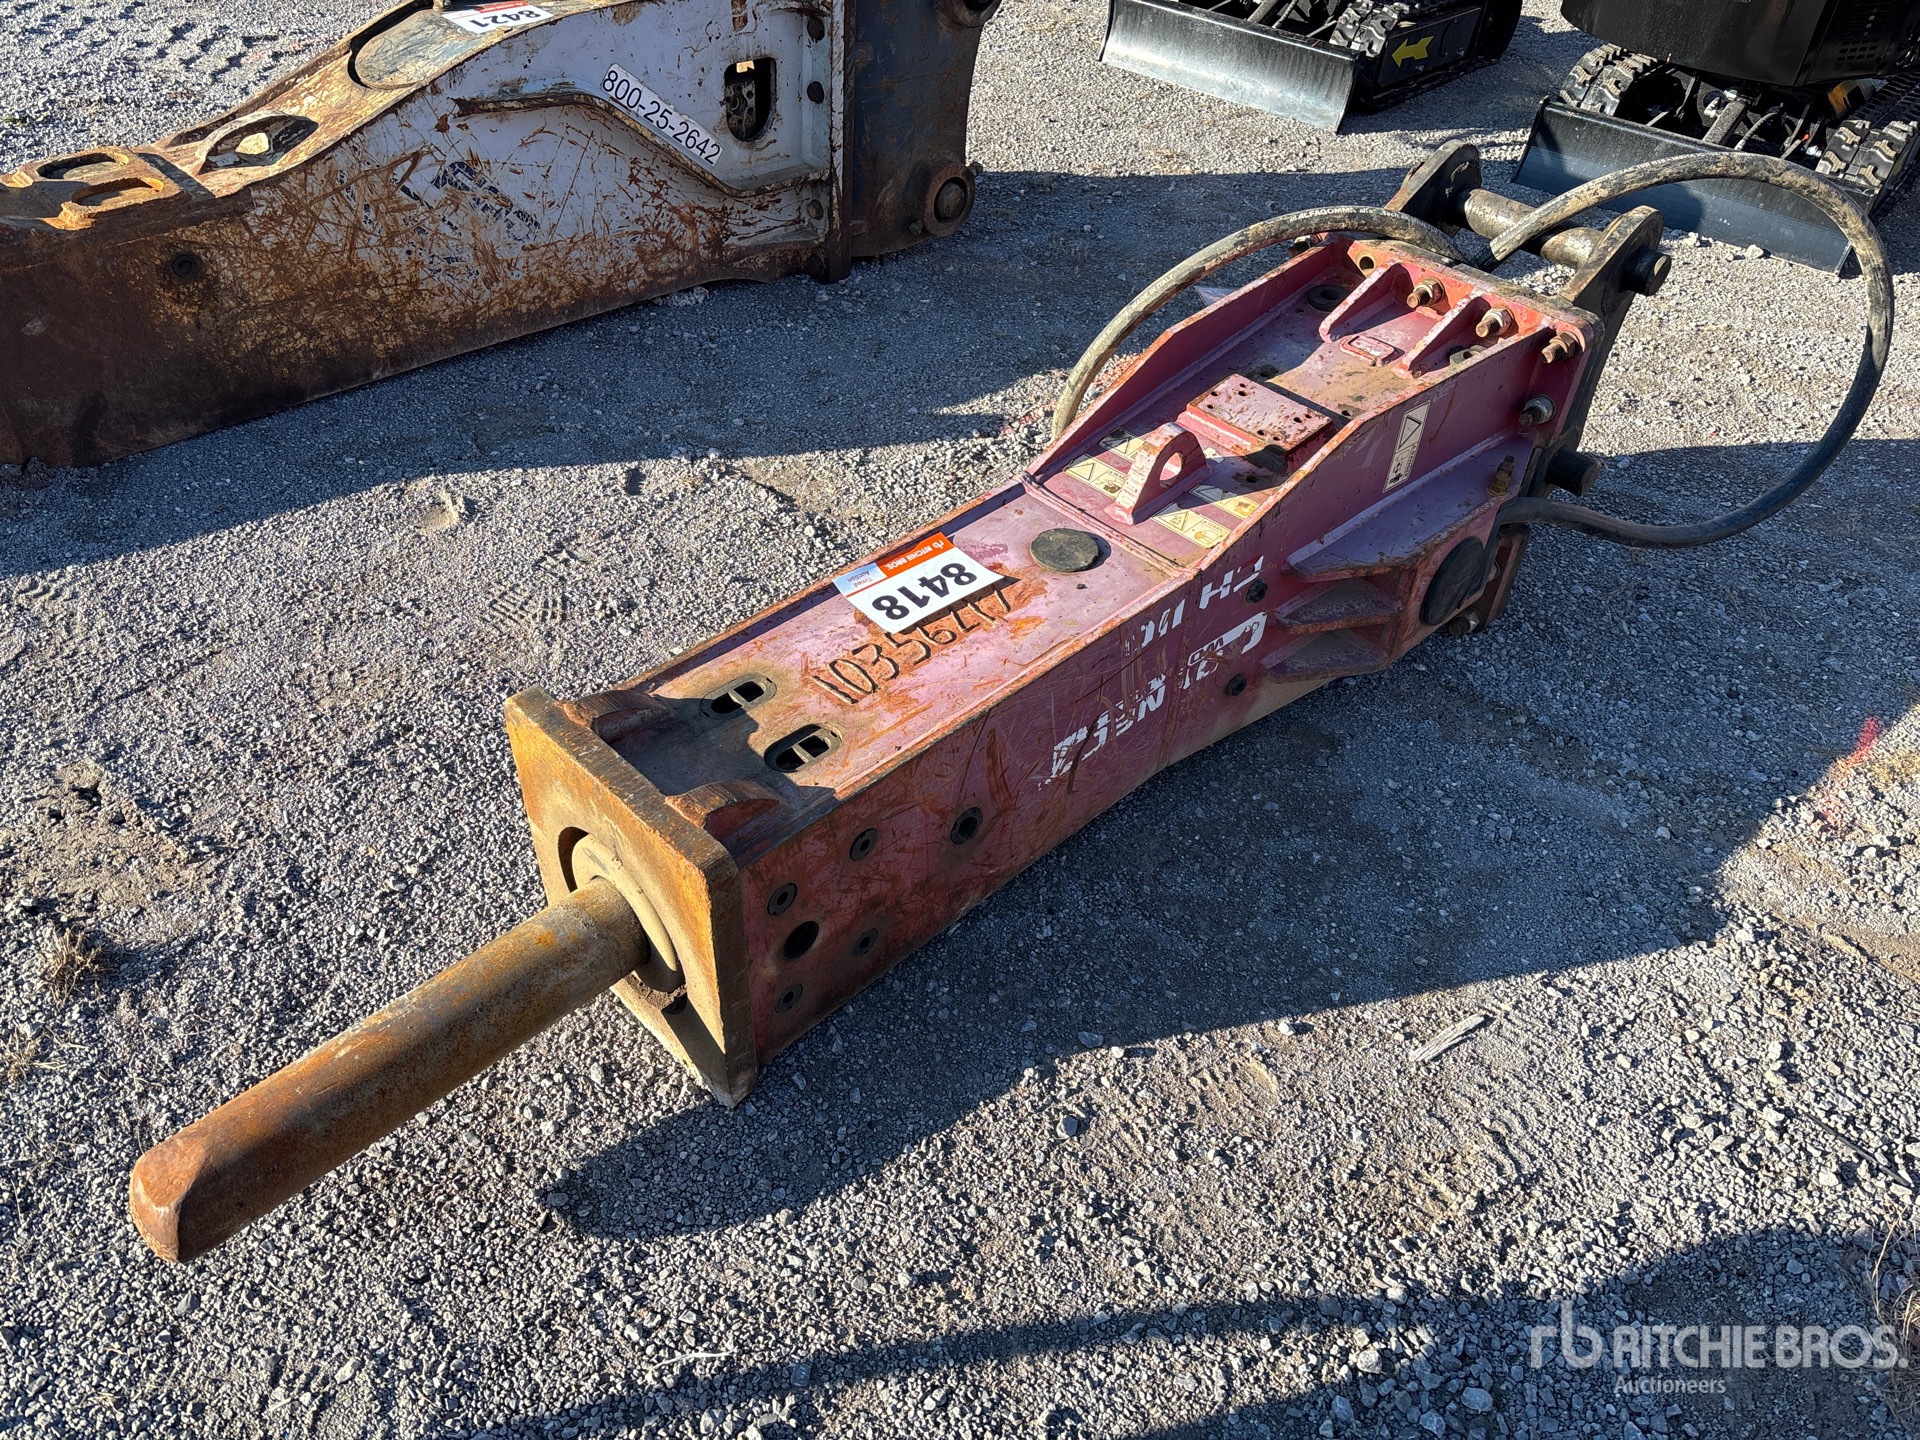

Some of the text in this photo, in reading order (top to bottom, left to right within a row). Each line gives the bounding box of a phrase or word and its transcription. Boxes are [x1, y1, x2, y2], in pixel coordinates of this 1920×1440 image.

[469, 10, 541, 28] 8421
[602, 69, 721, 165] 800-25-2642
[906, 545, 933, 561] RITCHIE
[847, 569, 870, 583] Auction
[853, 577, 873, 588] Timed
[871, 562, 978, 621] 8418
